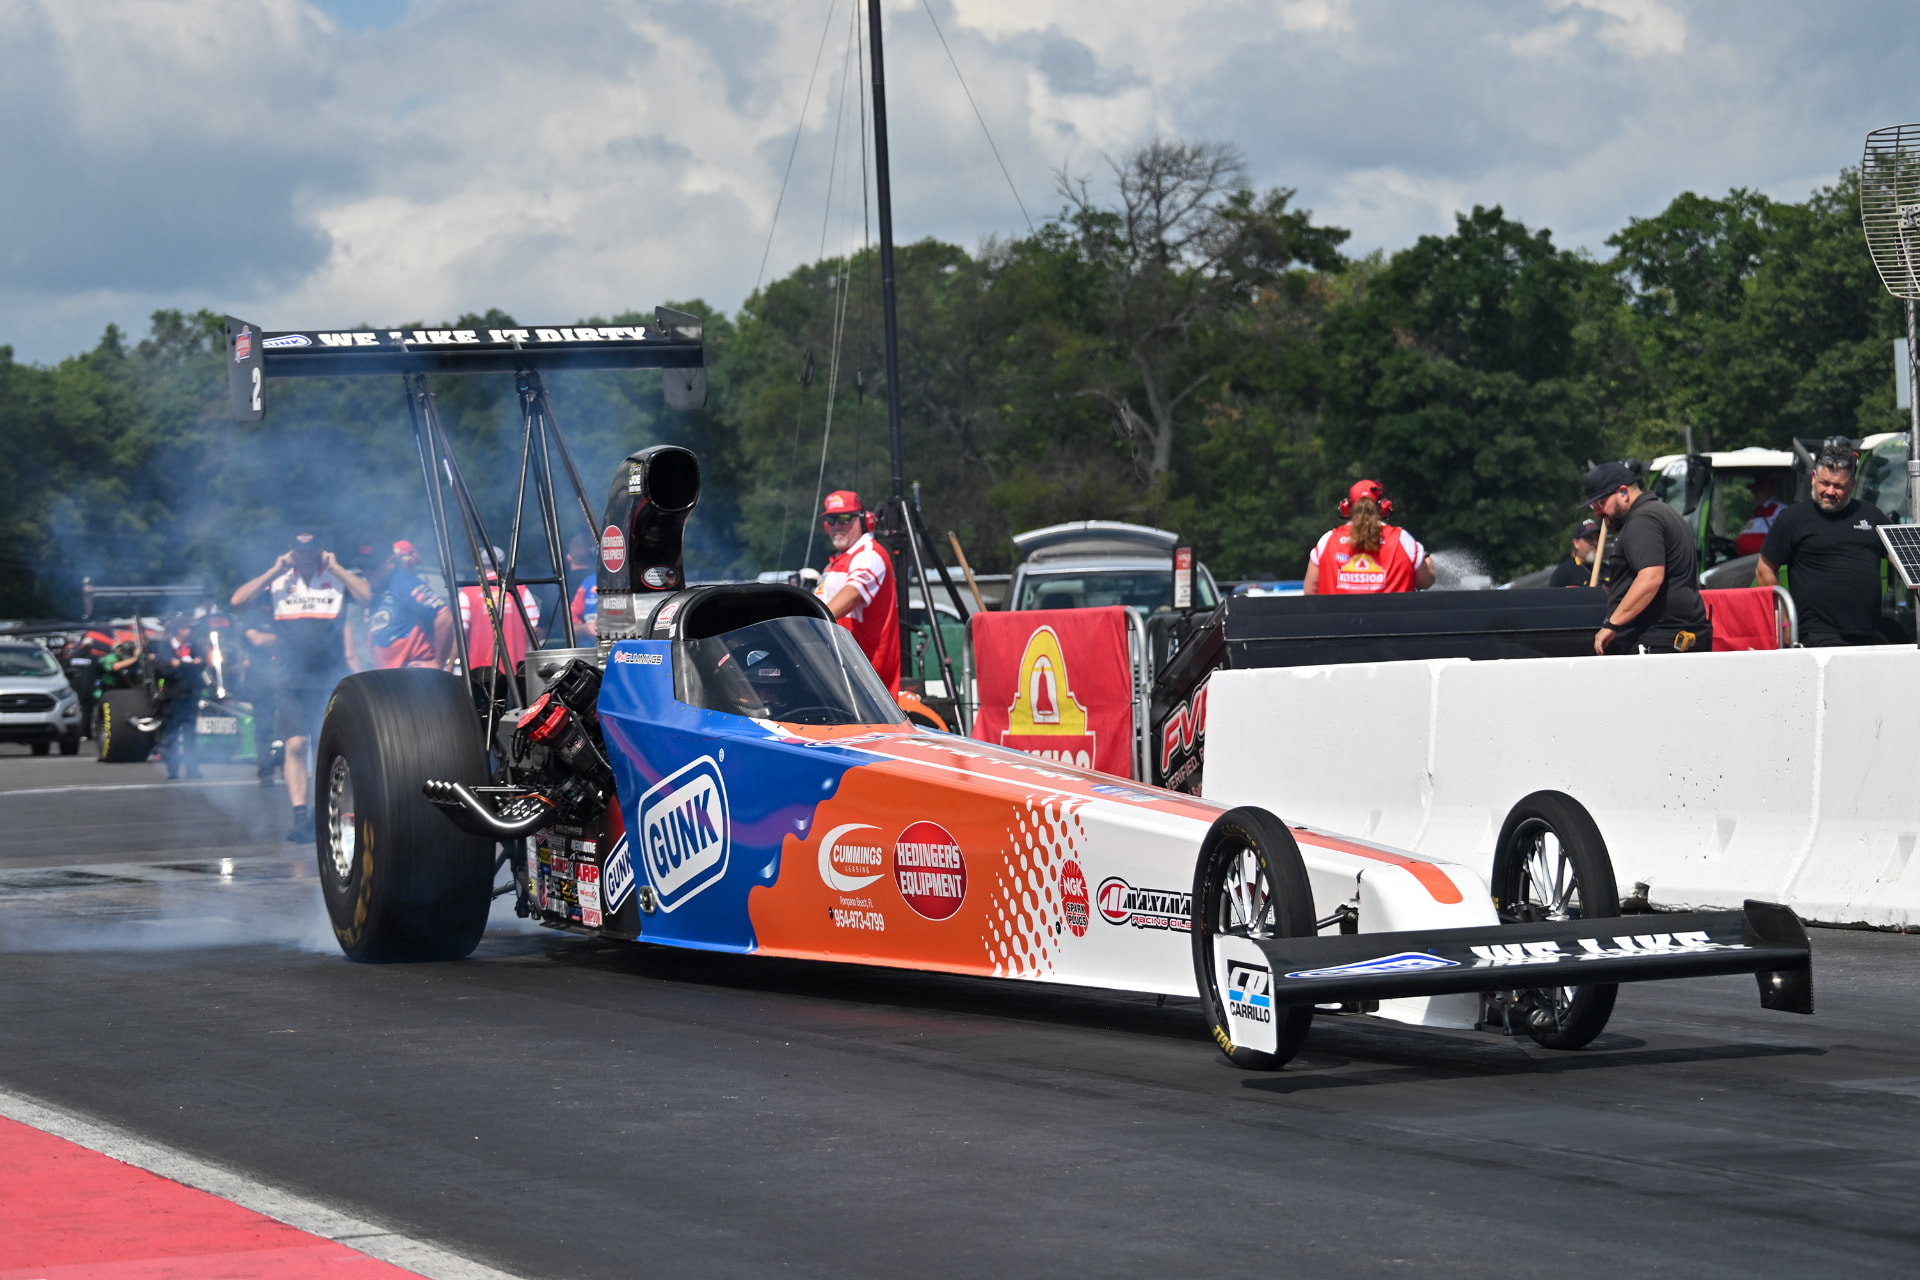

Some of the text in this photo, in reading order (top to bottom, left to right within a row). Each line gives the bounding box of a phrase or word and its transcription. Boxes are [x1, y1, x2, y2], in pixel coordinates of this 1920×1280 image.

[318, 327, 646, 347] WE LIKE IT DIRTY
[252, 367, 262, 411] 2
[1340, 573, 1384, 584] MISSION
[650, 787, 719, 880] GUNK
[833, 844, 882, 866] CUMMINGS
[896, 841, 961, 869] HEDINGER'S
[575, 863, 599, 883] ARP
[844, 865, 870, 874] LEASING
[899, 871, 963, 899] EQUIPMENT
[1062, 877, 1084, 897] NGK
[1066, 902, 1085, 915] SPARK
[834, 908, 885, 932] 954-973-4799
[1068, 914, 1087, 926] PLUGS
[1170, 918, 1192, 929] OILS
[1229, 1001, 1271, 1024] CARRILLO
[1212, 1024, 1238, 1056] EAGLE
